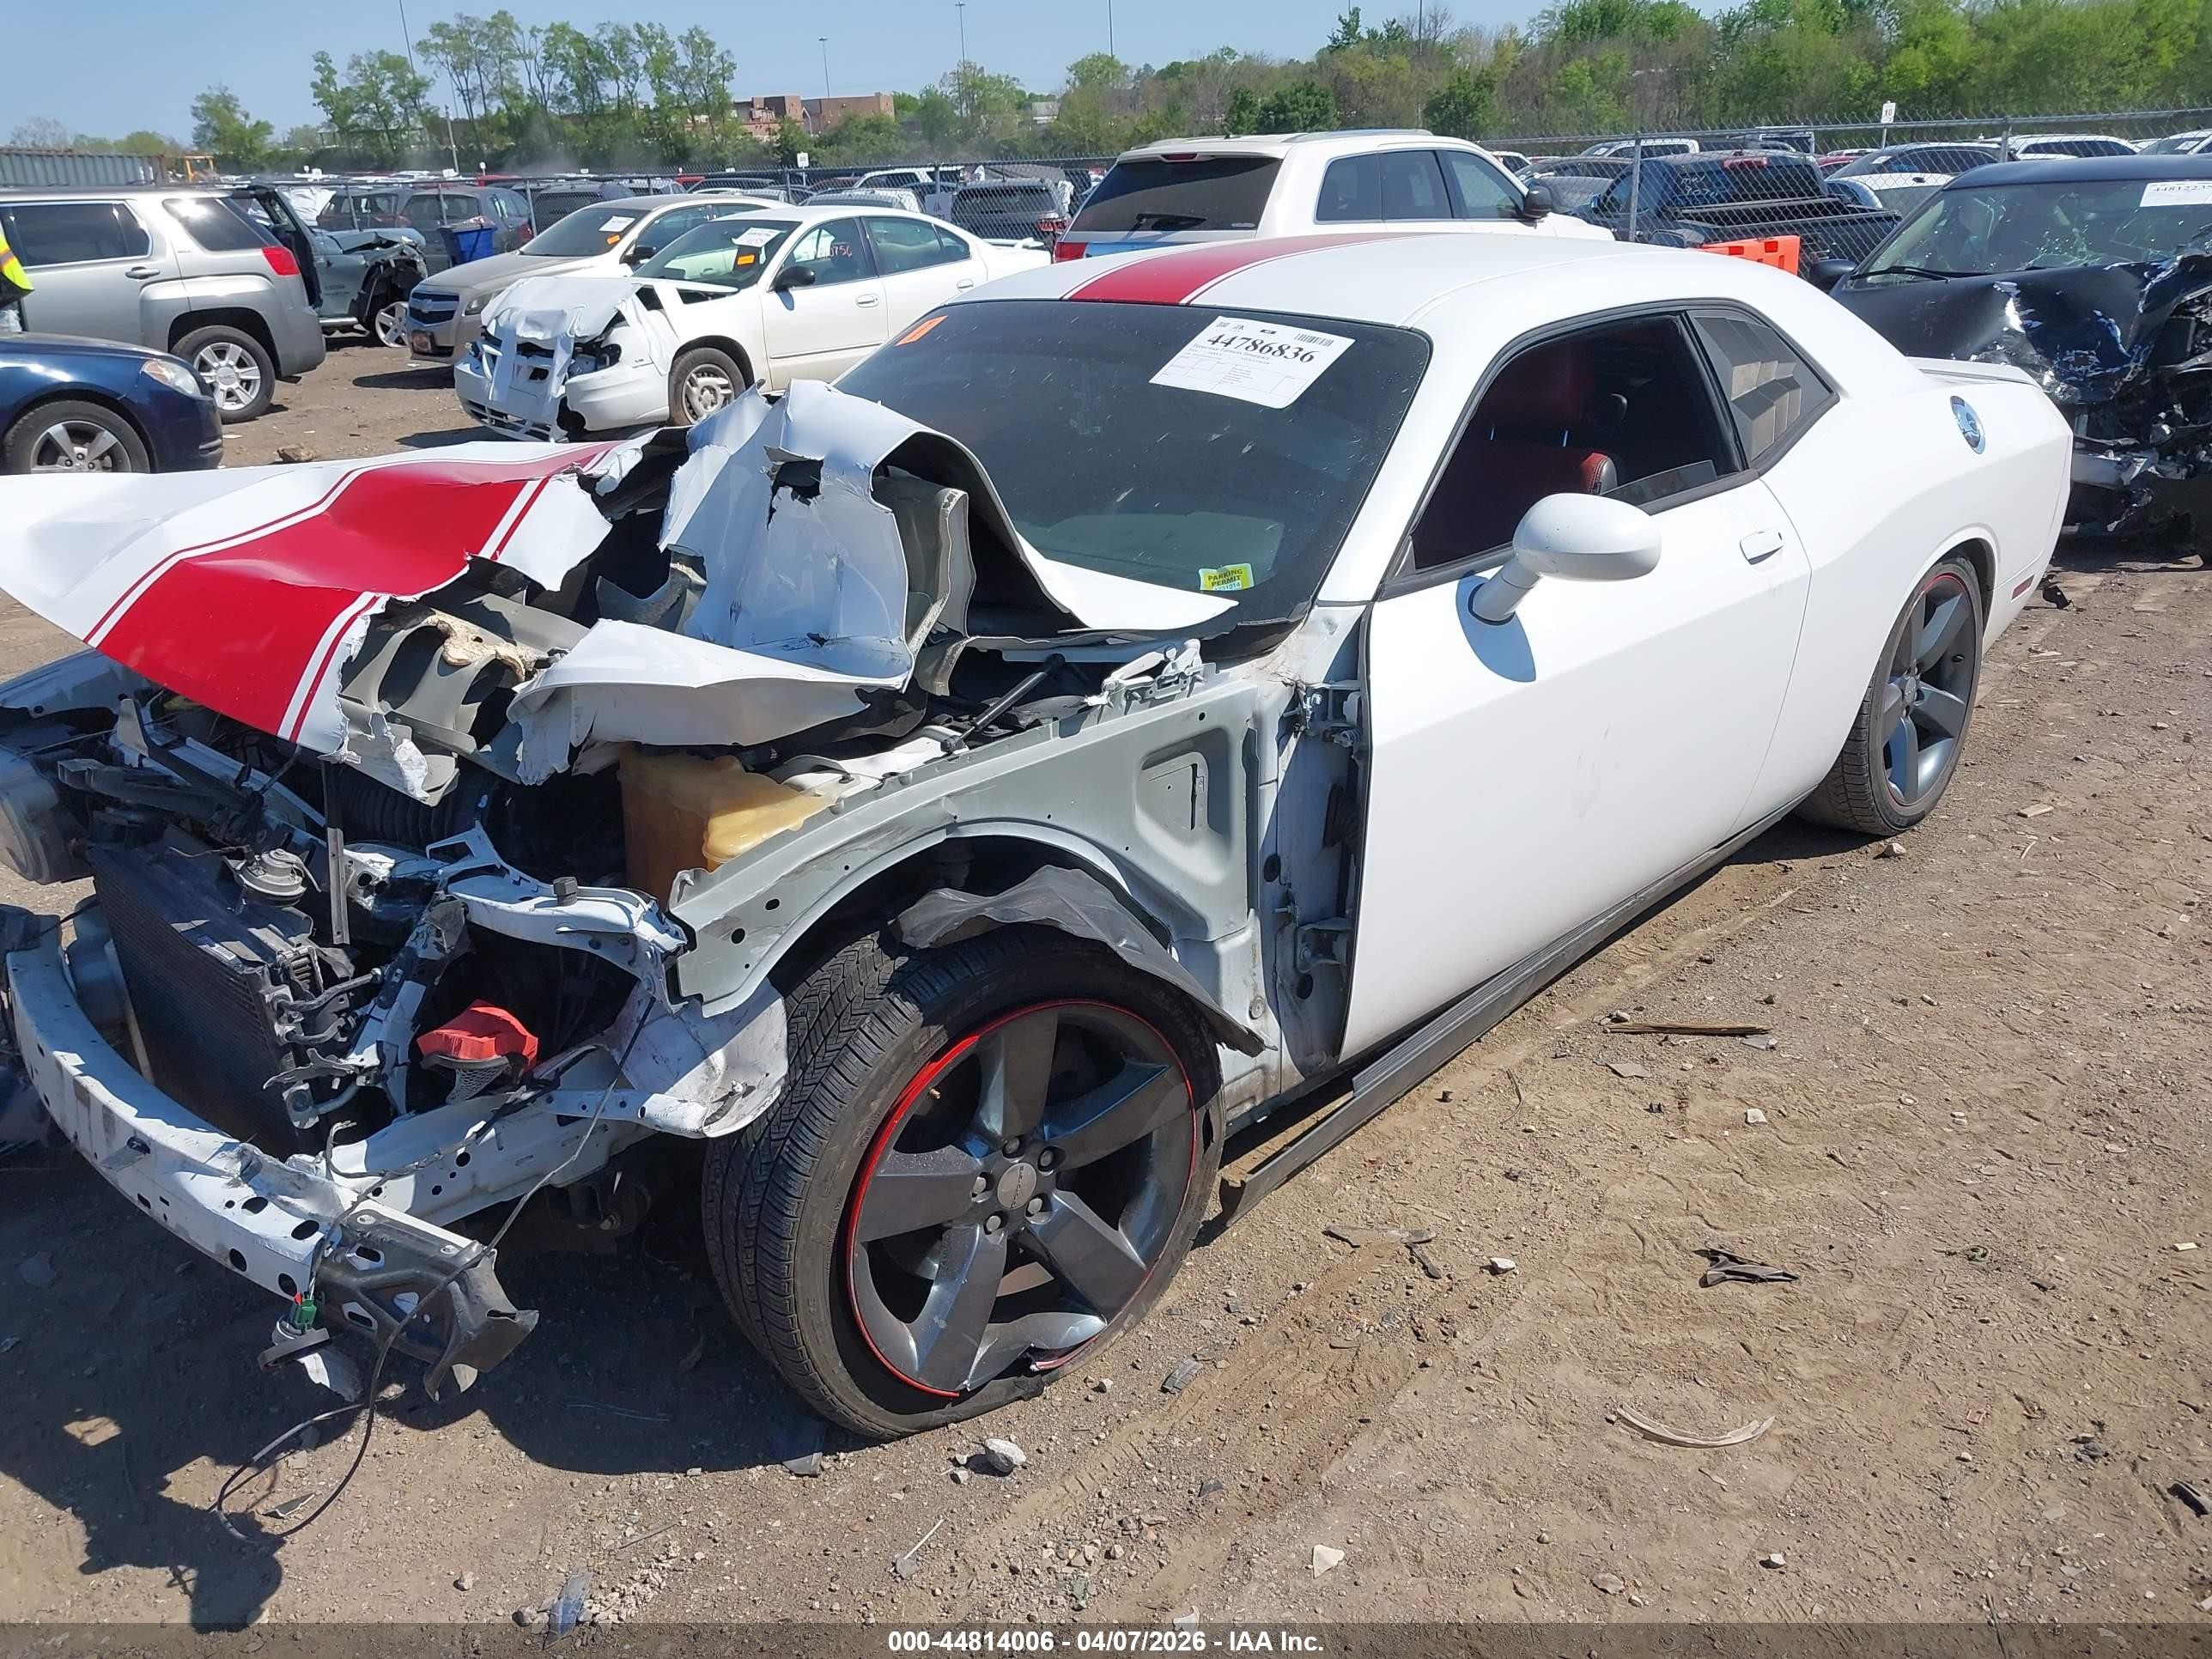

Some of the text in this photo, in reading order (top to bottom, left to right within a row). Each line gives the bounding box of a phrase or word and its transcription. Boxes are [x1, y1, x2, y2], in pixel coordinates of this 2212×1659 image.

[1206, 333, 1319, 364] 44786836
[1207, 568, 1243, 581] PARKING
[1211, 574, 1242, 587] PERMIT
